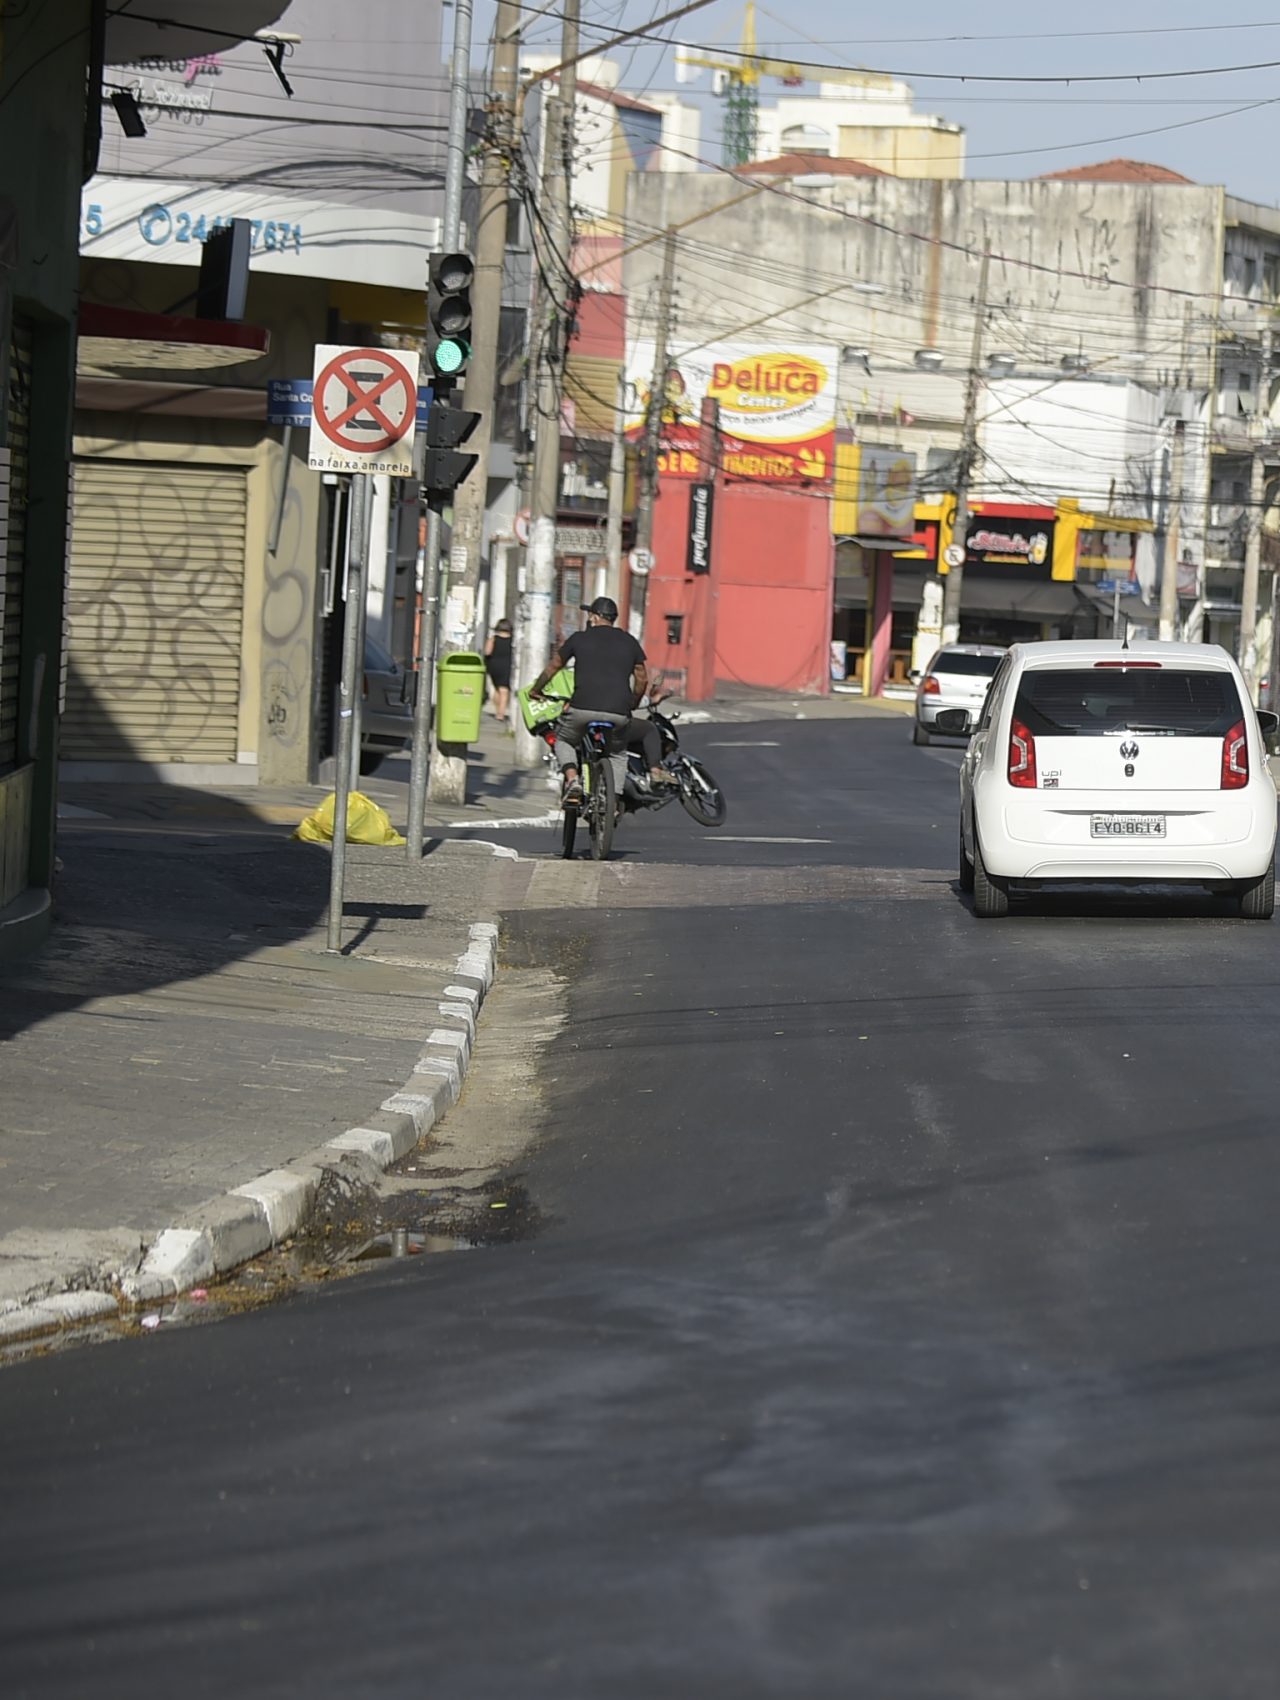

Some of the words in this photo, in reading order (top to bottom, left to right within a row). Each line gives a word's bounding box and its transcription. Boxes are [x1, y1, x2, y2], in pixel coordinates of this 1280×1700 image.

[712, 362, 819, 394] Deluca
[310, 458, 324, 468] na
[328, 457, 358, 469] faixa
[361, 461, 410, 473] amarela
[692, 488, 708, 566] perfumaria
